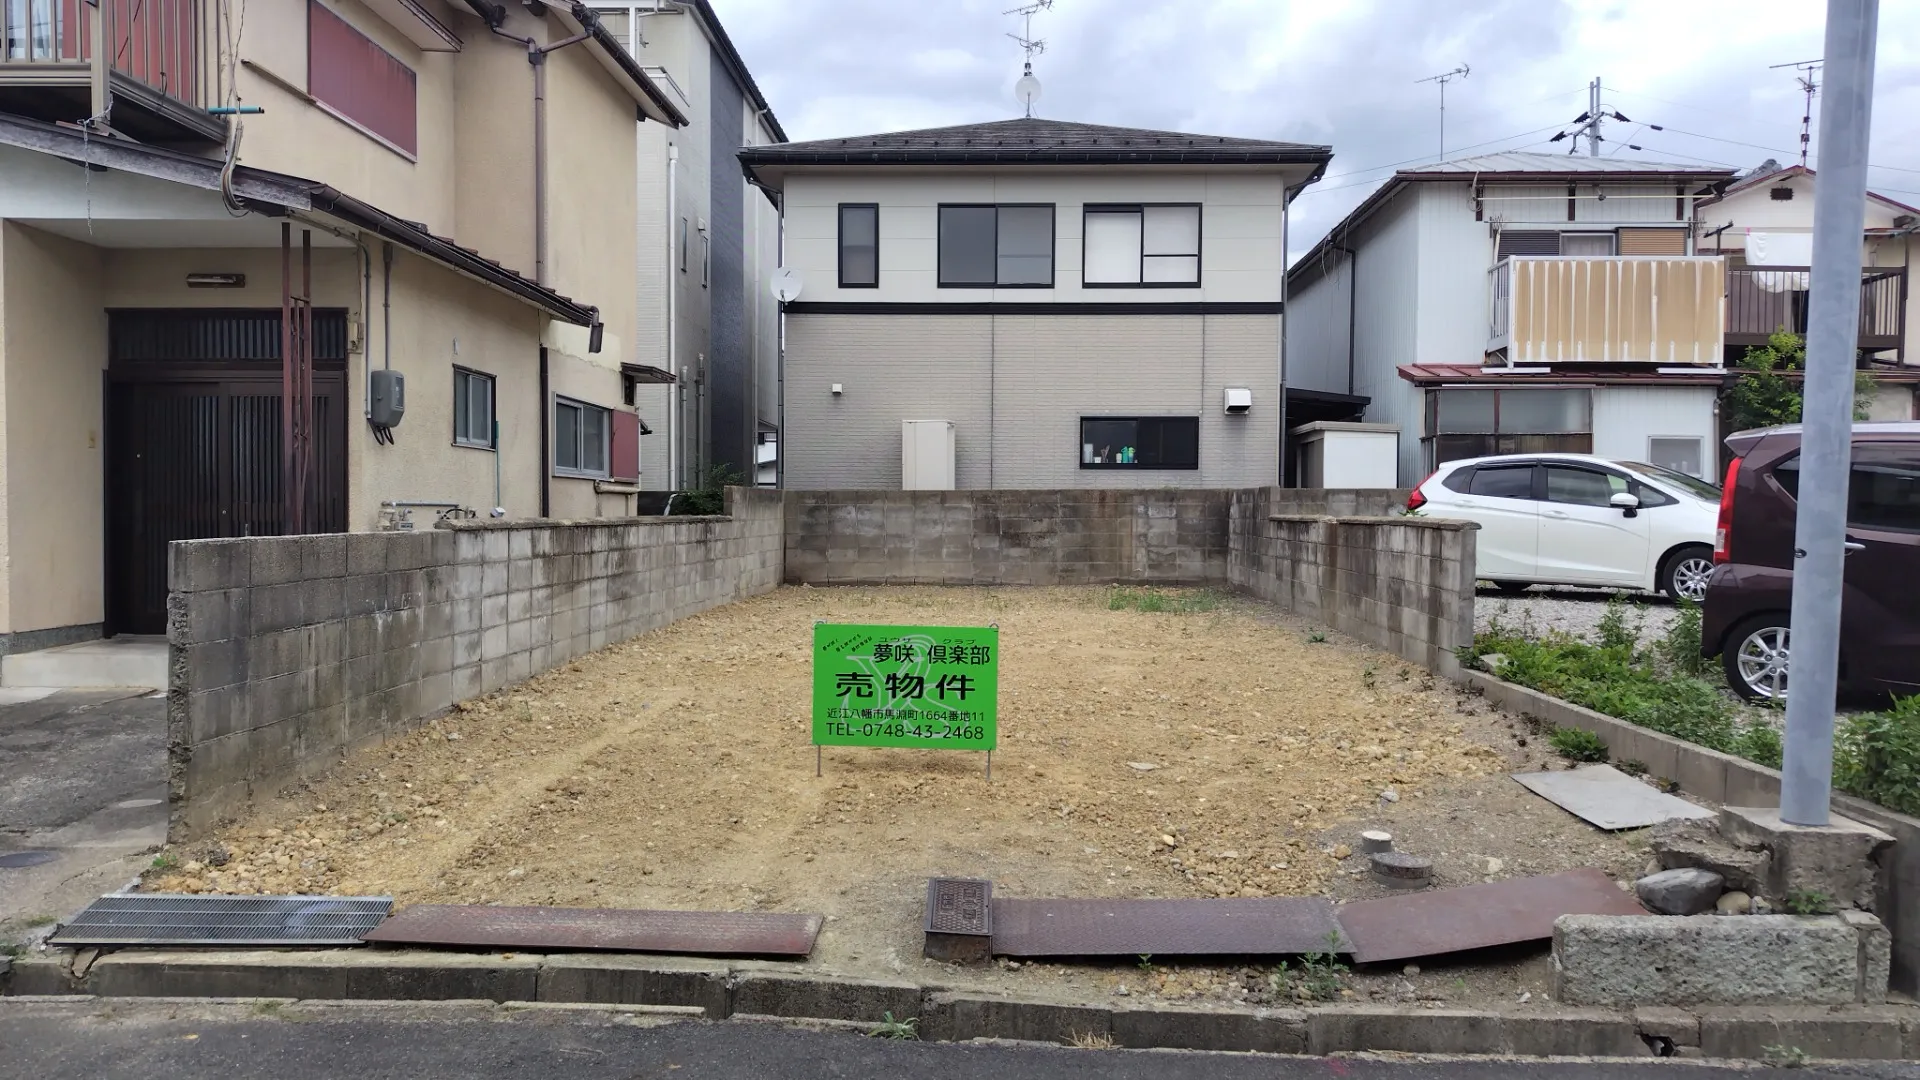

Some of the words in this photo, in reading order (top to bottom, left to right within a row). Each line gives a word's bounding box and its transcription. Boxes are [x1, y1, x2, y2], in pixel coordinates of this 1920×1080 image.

[873, 643, 915, 664] 夢咲
[927, 644, 991, 666] 倶楽部
[835, 671, 976, 700] 売物件
[826, 722, 985, 740] TEL-0748-43-2468
